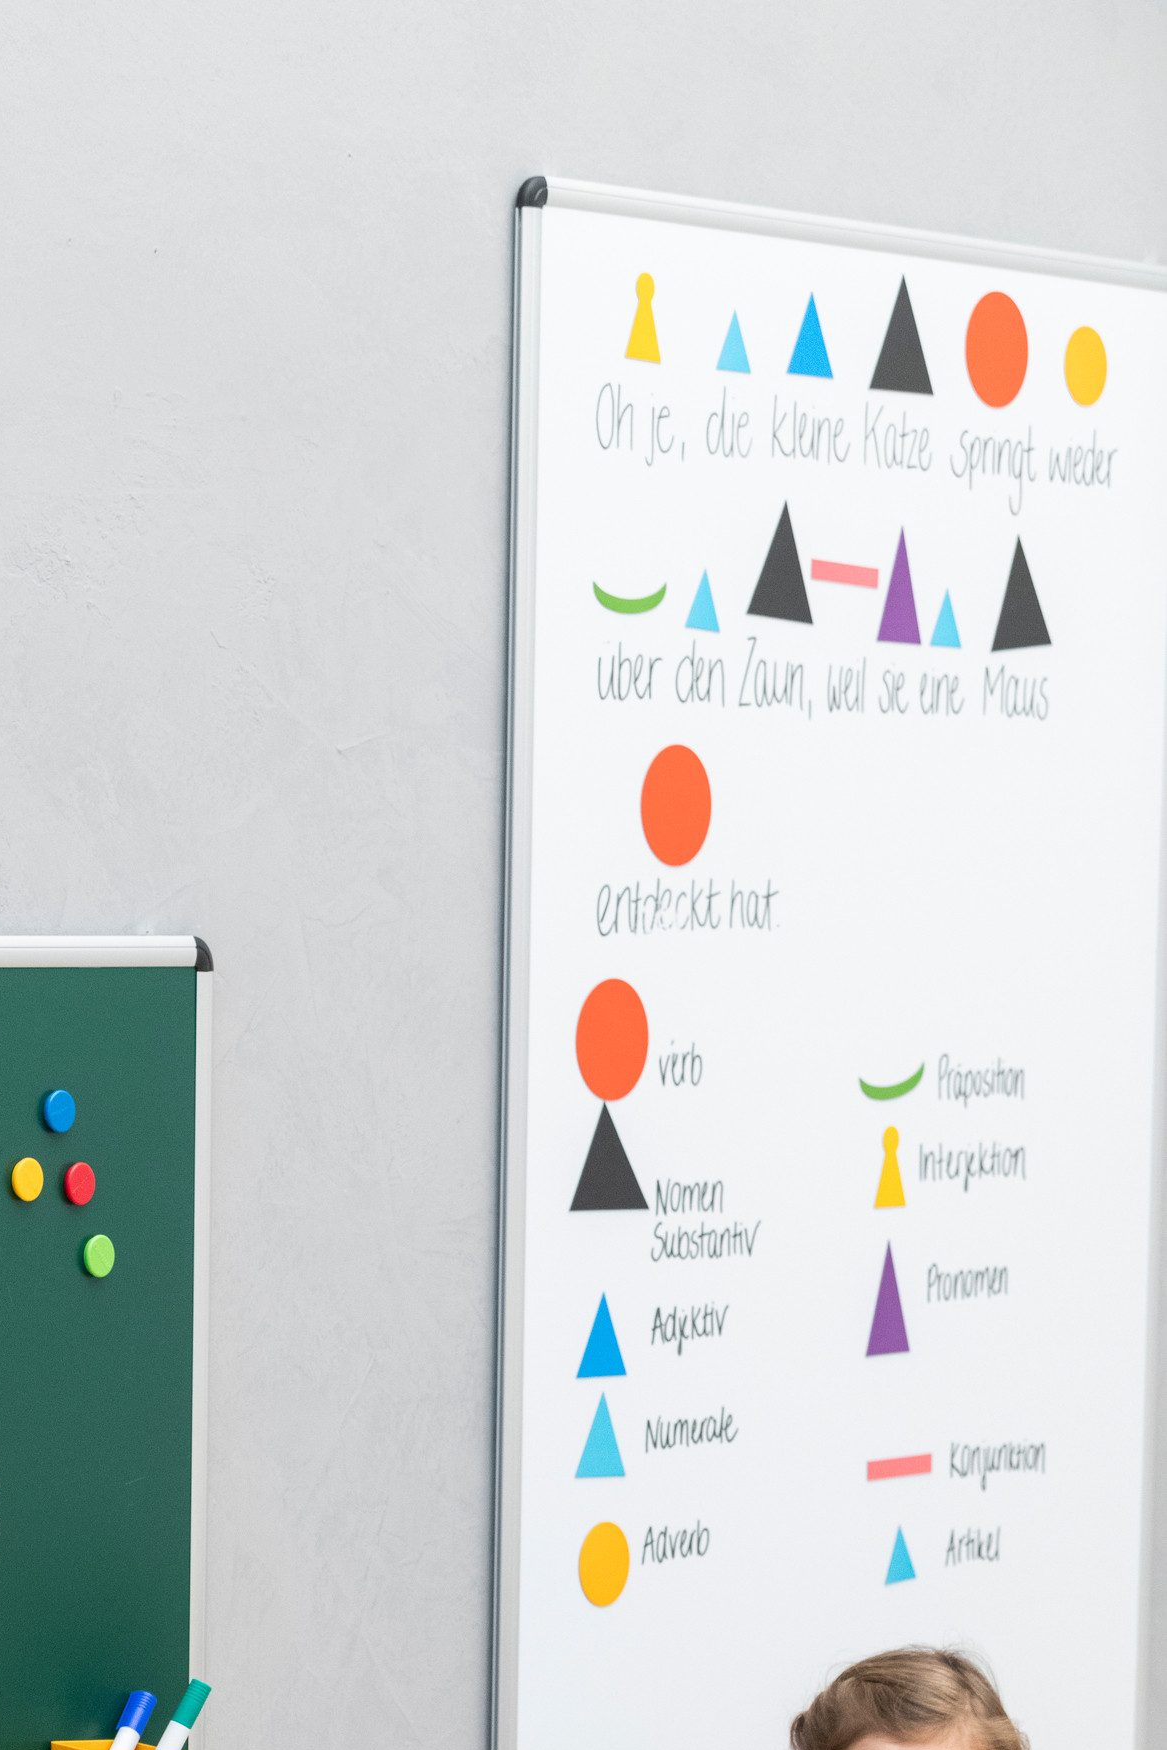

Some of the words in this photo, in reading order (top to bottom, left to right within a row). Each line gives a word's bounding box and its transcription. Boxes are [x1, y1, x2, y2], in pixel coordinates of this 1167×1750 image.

[596, 382, 634, 451] Oh
[645, 392, 685, 467] je,
[706, 385, 753, 458] die
[863, 400, 933, 472] Katze
[1048, 429, 1118, 488] wieder
[675, 638, 725, 708] den
[738, 636, 812, 721] Zaun,
[826, 656, 867, 714] weil
[878, 664, 910, 714] sie
[920, 671, 965, 716] eine
[983, 663, 1049, 721] Maus
[597, 877, 722, 937] entdeckt
[919, 1140, 1027, 1193] Interjektion
[655, 1178, 724, 1216] Nomen
[651, 1219, 762, 1263] Substantiv
[927, 1262, 1009, 1303] Pronomen
[949, 1440, 1046, 1492] Konjunktion
[641, 1519, 711, 1565] Adverb
[944, 1526, 1001, 1567] Artikel
